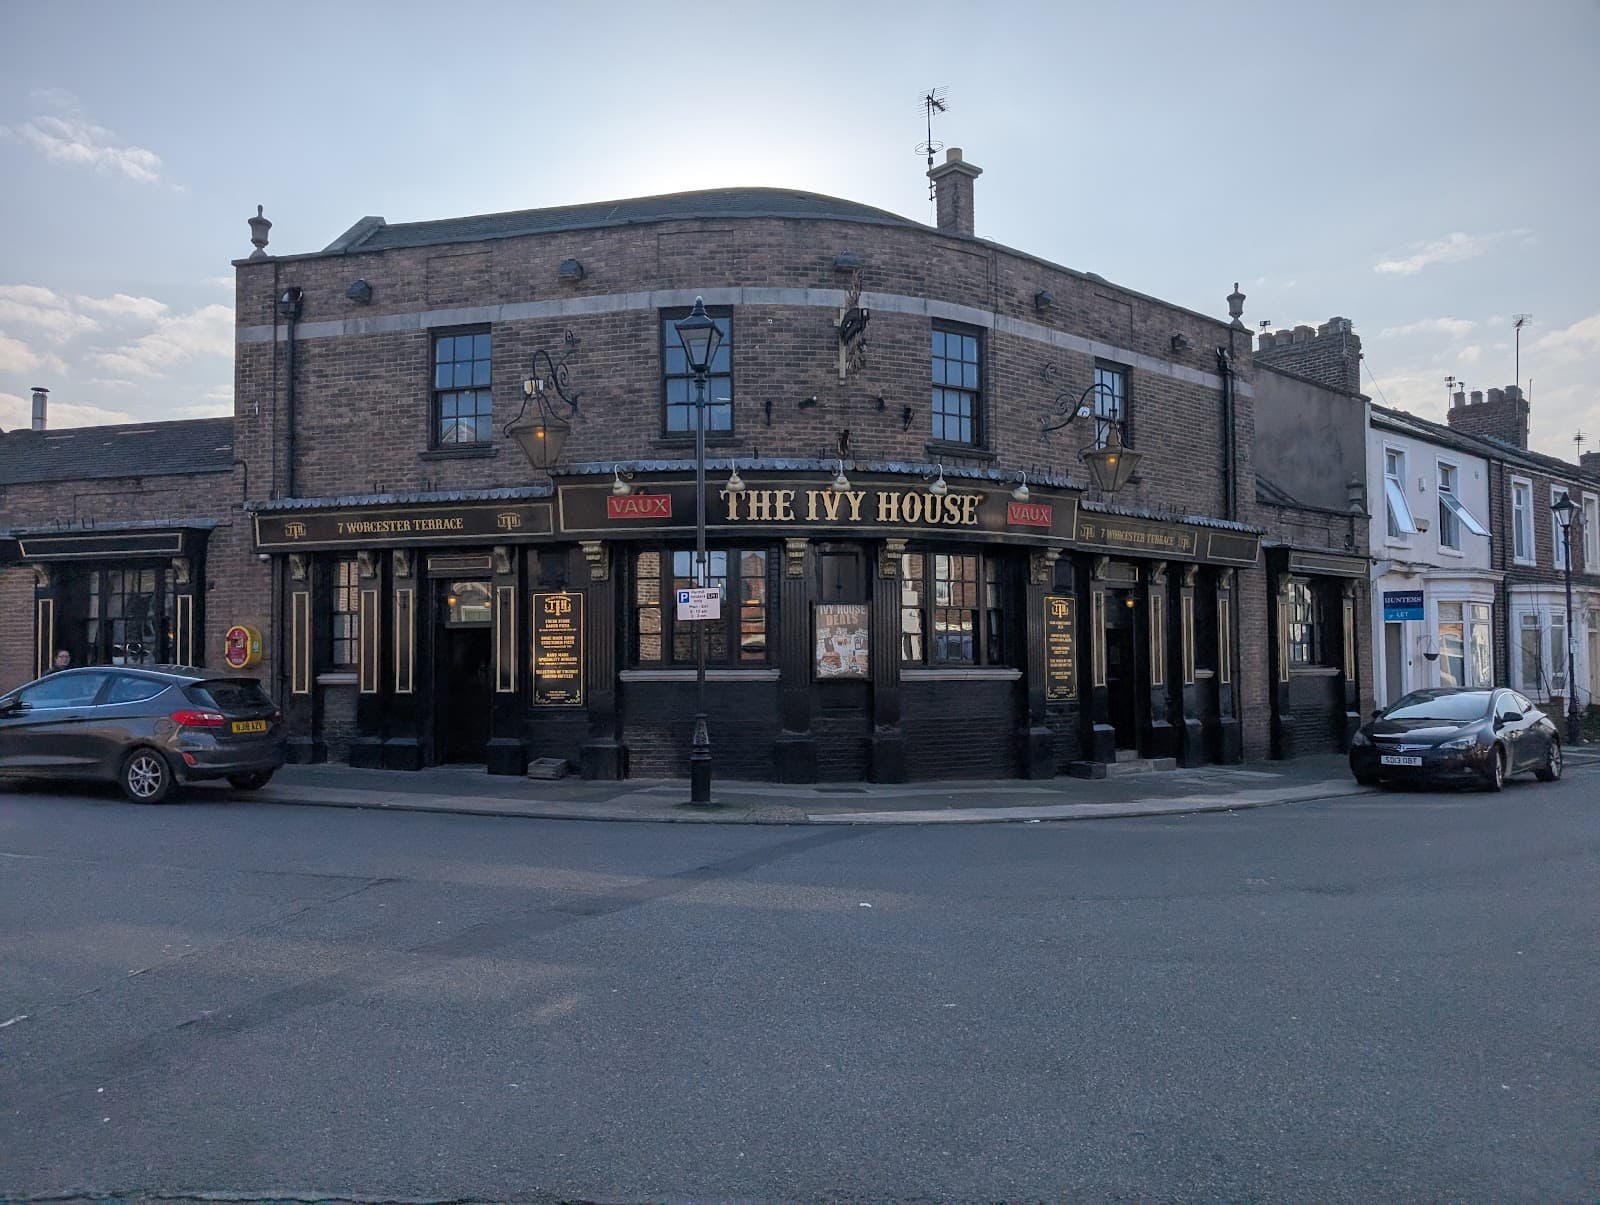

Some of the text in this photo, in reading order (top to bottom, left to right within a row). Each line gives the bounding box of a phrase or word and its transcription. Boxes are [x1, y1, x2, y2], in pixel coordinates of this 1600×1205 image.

[610, 498, 668, 514] VAUX
[719, 489, 980, 525] THE IVY HOUSE
[1010, 505, 1050, 523] VAUX
[337, 517, 464, 534] 7 WORCESTER TERRACE
[1100, 528, 1175, 546] 7 WORCESTER TERRACE
[680, 593, 689, 602] P
[1384, 596, 1422, 604] HUNTERS
[819, 604, 866, 615] IVY HOUSE
[825, 614, 859, 626] DEALS
